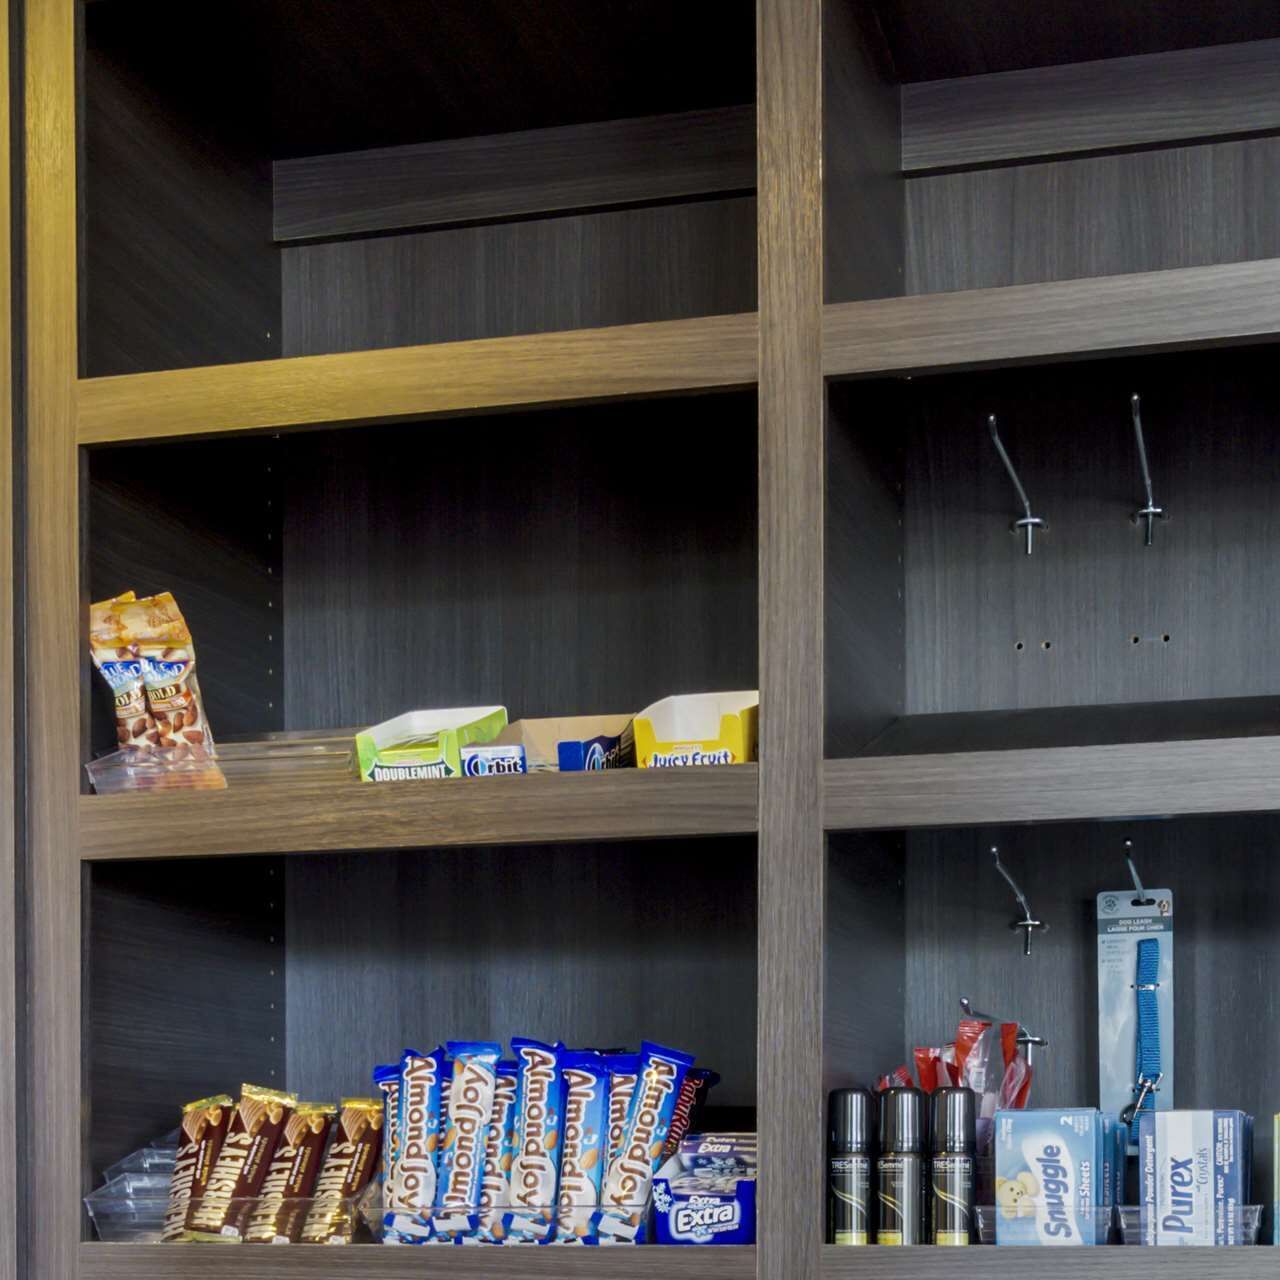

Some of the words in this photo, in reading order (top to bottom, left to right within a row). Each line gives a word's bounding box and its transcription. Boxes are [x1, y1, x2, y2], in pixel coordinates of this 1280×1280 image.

[374, 765, 447, 782] DOUBLEMINT
[465, 754, 522, 777] Orbit
[649, 751, 689, 767] Juicy
[692, 748, 732, 765] Fruit
[1060, 1115, 1073, 1126] 2
[1144, 1135, 1156, 1173] Detergent
[1196, 1147, 1211, 1185] Crystals
[192, 1131, 254, 1227] HERSHEY'S
[1035, 1143, 1073, 1240] Snuggle
[1079, 1160, 1092, 1200] Sheets
[1145, 1174, 1155, 1203] Powder
[1161, 1156, 1195, 1234] Purex
[676, 1204, 736, 1233] Extra
